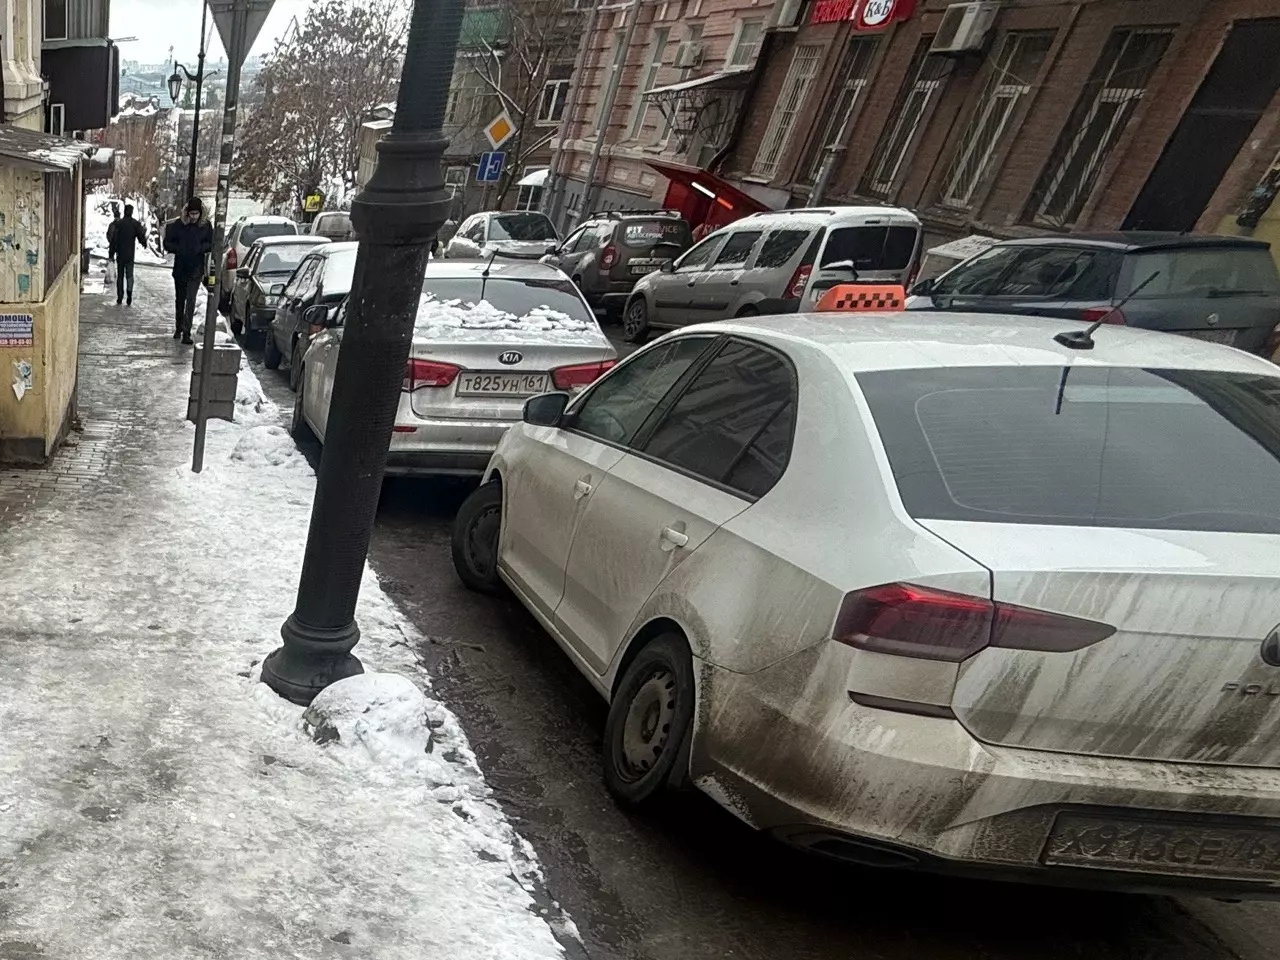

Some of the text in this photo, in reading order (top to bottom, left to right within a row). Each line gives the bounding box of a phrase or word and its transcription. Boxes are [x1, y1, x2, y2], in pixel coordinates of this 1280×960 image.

[626, 226, 643, 234] FIT
[502, 353, 520, 362] KIA
[522, 375, 544, 388] 161
